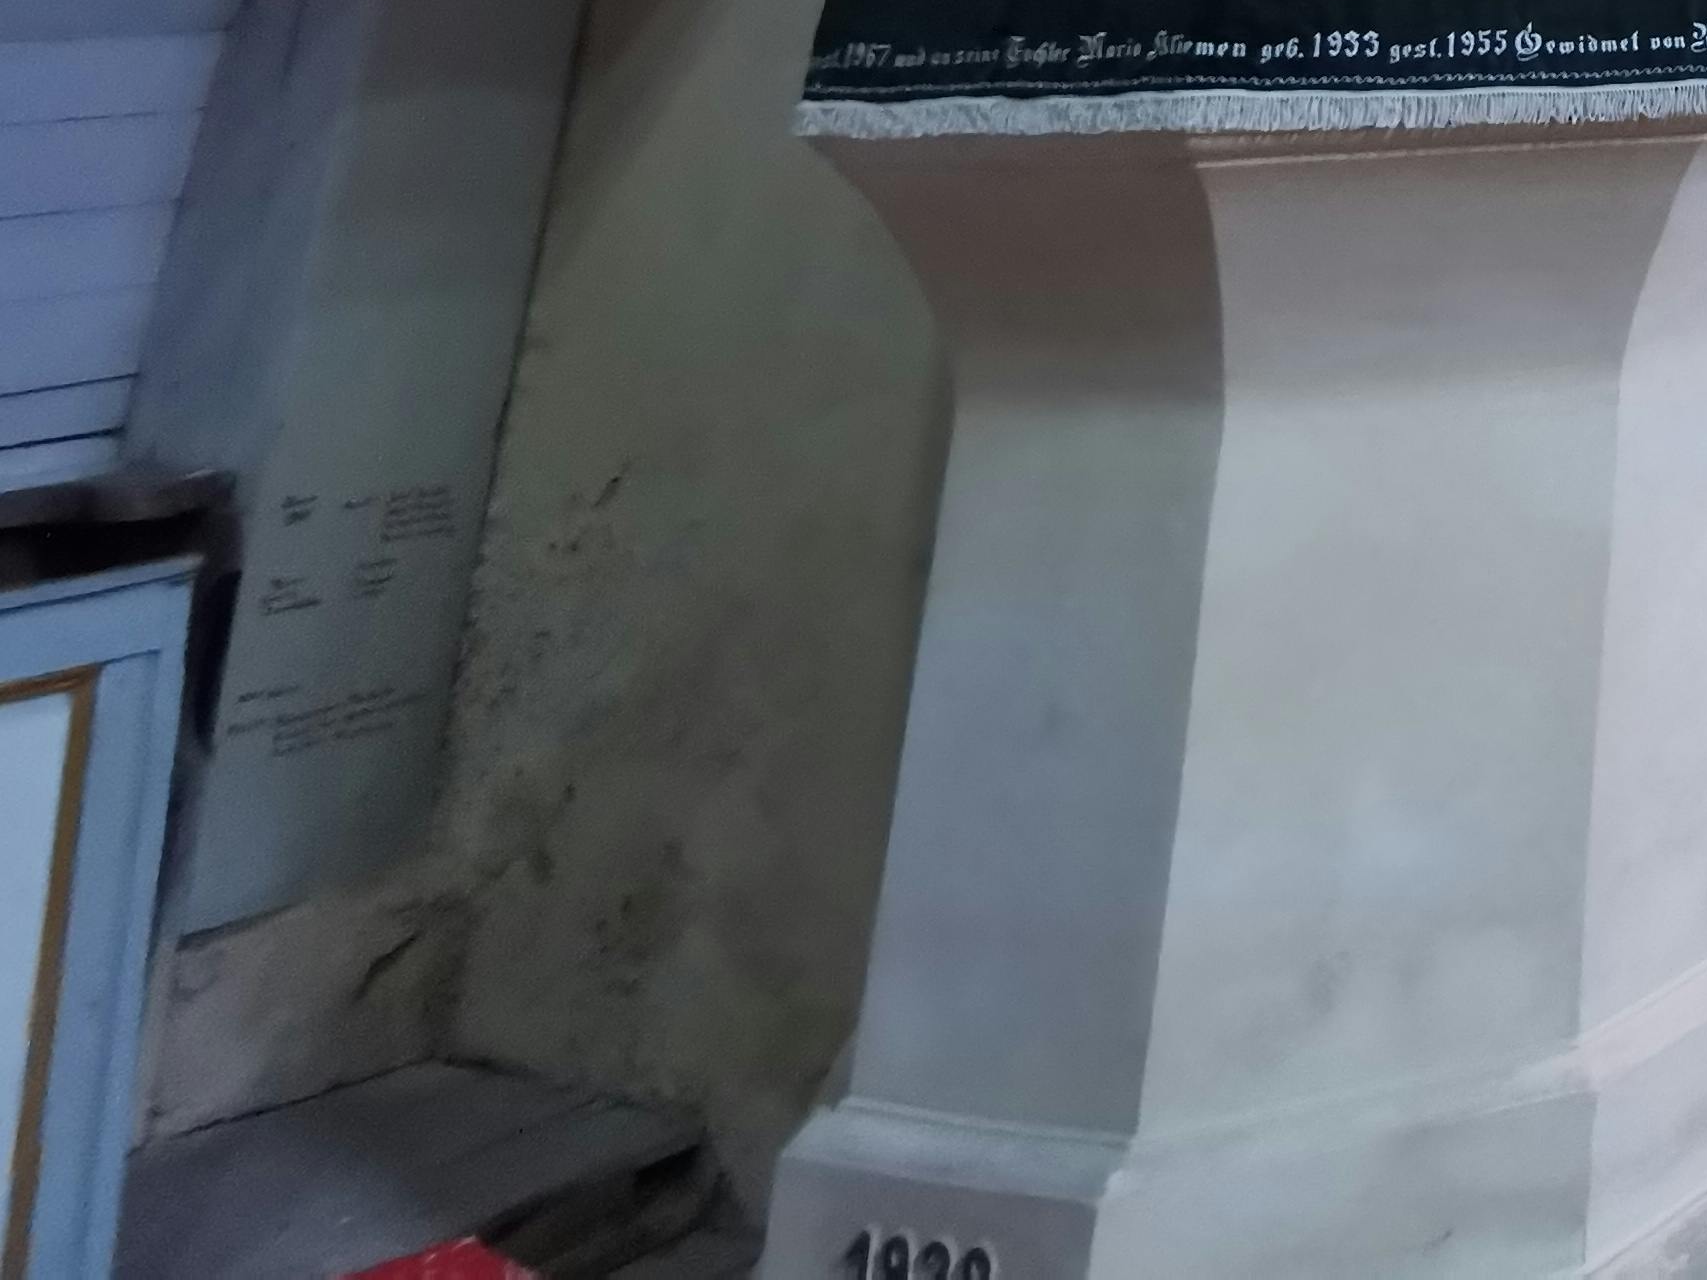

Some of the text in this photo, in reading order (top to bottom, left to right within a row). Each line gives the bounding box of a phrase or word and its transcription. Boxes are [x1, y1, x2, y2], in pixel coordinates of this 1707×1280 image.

[1259, 37, 1306, 65] geb.
[1312, 30, 1382, 60] 1933
[1446, 29, 1510, 59] 1955
[1513, 20, 1642, 62] Gewidmet
[1648, 34, 1687, 51] von
